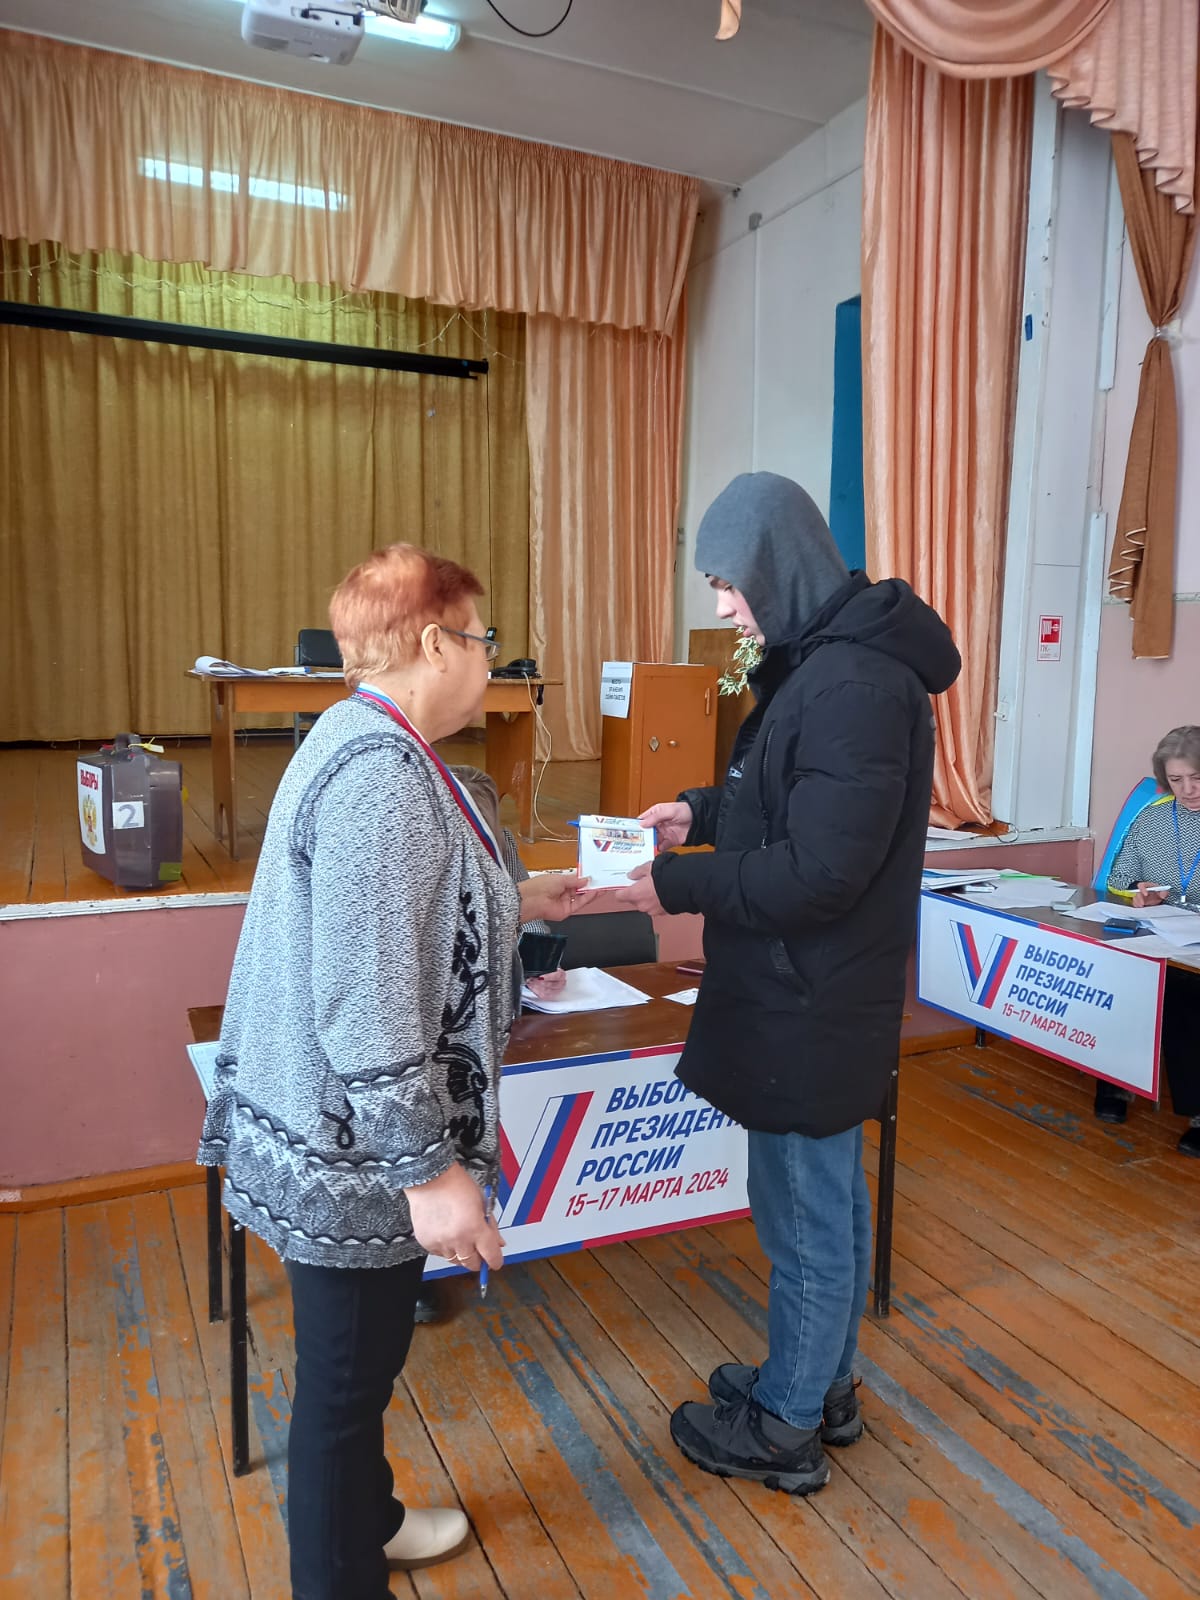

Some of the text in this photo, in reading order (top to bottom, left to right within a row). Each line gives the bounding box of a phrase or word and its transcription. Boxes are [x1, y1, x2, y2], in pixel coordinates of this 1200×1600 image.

[118, 804, 139, 827] 2
[1023, 943, 1094, 979] ВЫБОРЫ
[1007, 983, 1069, 1018] РОССИИ
[1015, 963, 1115, 1011] ПРЕЗИДЕНТА
[1030, 1013, 1067, 1039] МАРТА
[1068, 1028, 1097, 1050] 2024
[591, 1106, 741, 1150] ПРЕЗИДЕН
[576, 1143, 686, 1186] РОССИИ
[619, 1175, 683, 1207] МАРТА
[685, 1167, 729, 1195] 2024
